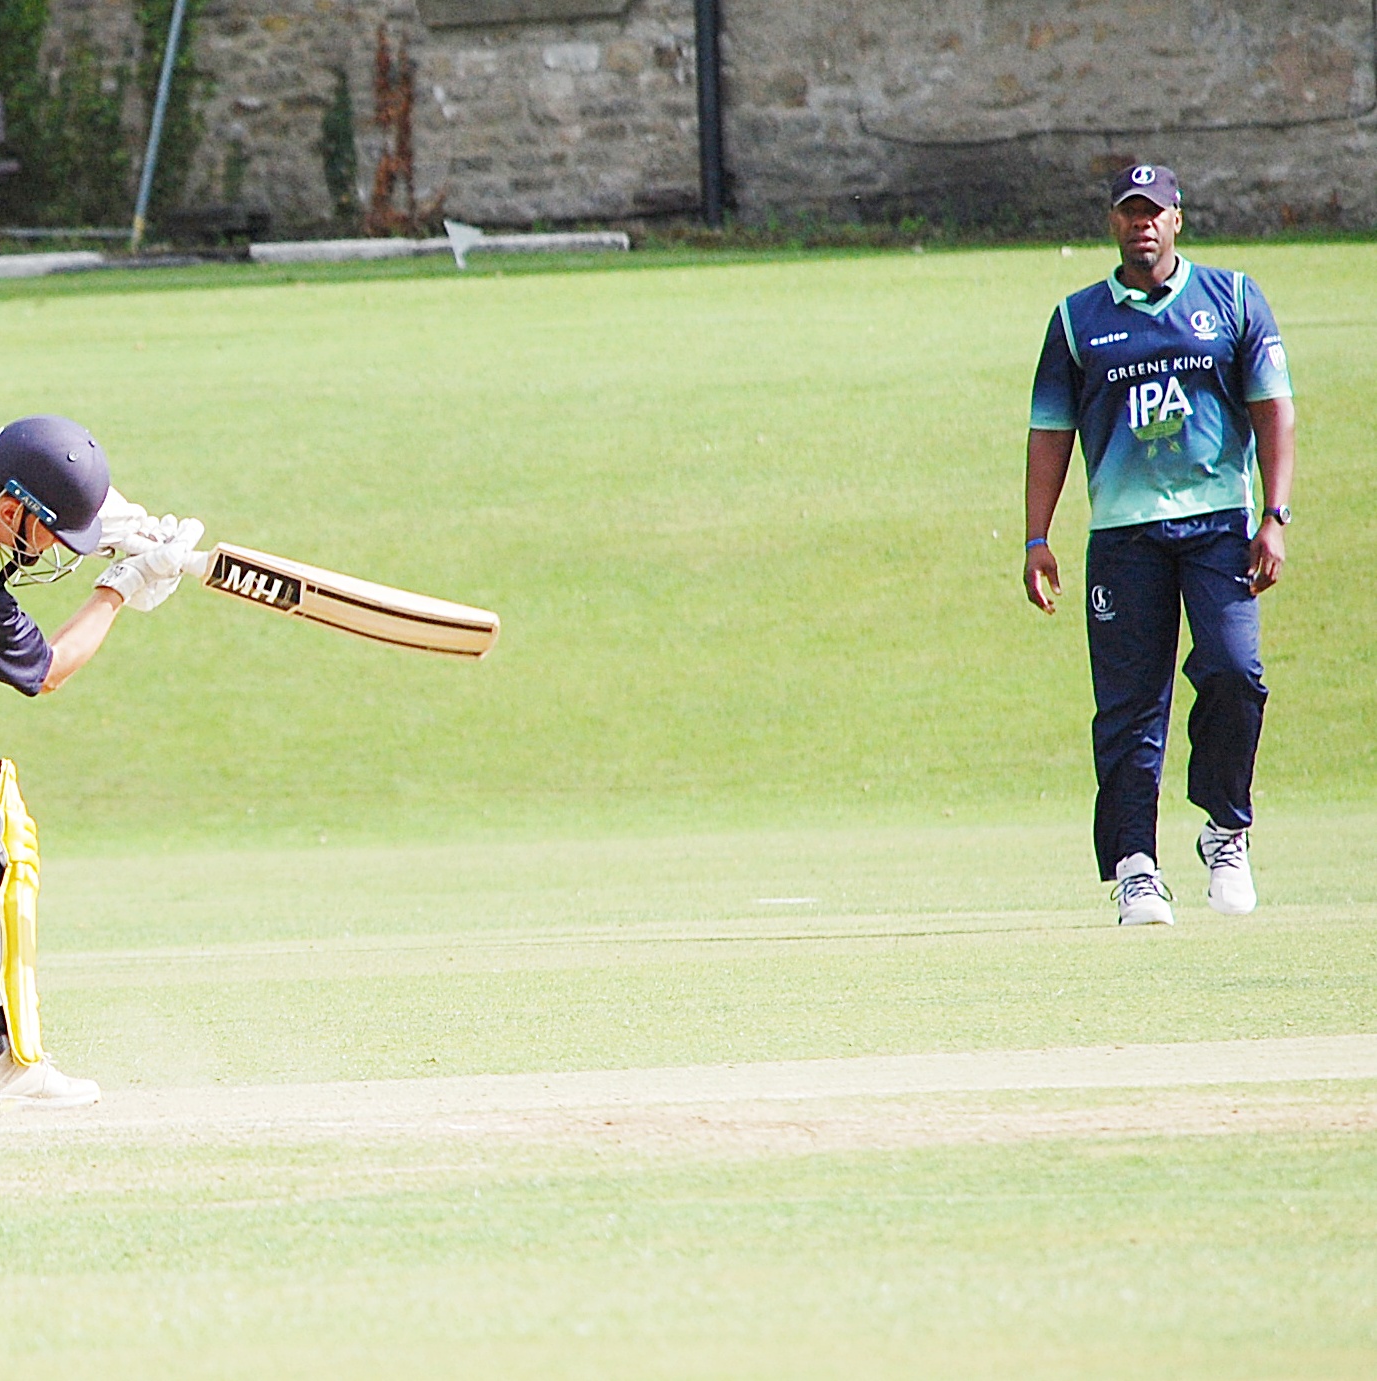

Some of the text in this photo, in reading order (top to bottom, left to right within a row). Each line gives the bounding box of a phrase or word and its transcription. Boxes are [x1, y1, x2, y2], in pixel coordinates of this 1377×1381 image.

[1107, 355, 1214, 382] GREENE KING
[1128, 375, 1194, 429] IPA
[222, 564, 283, 604] MH
